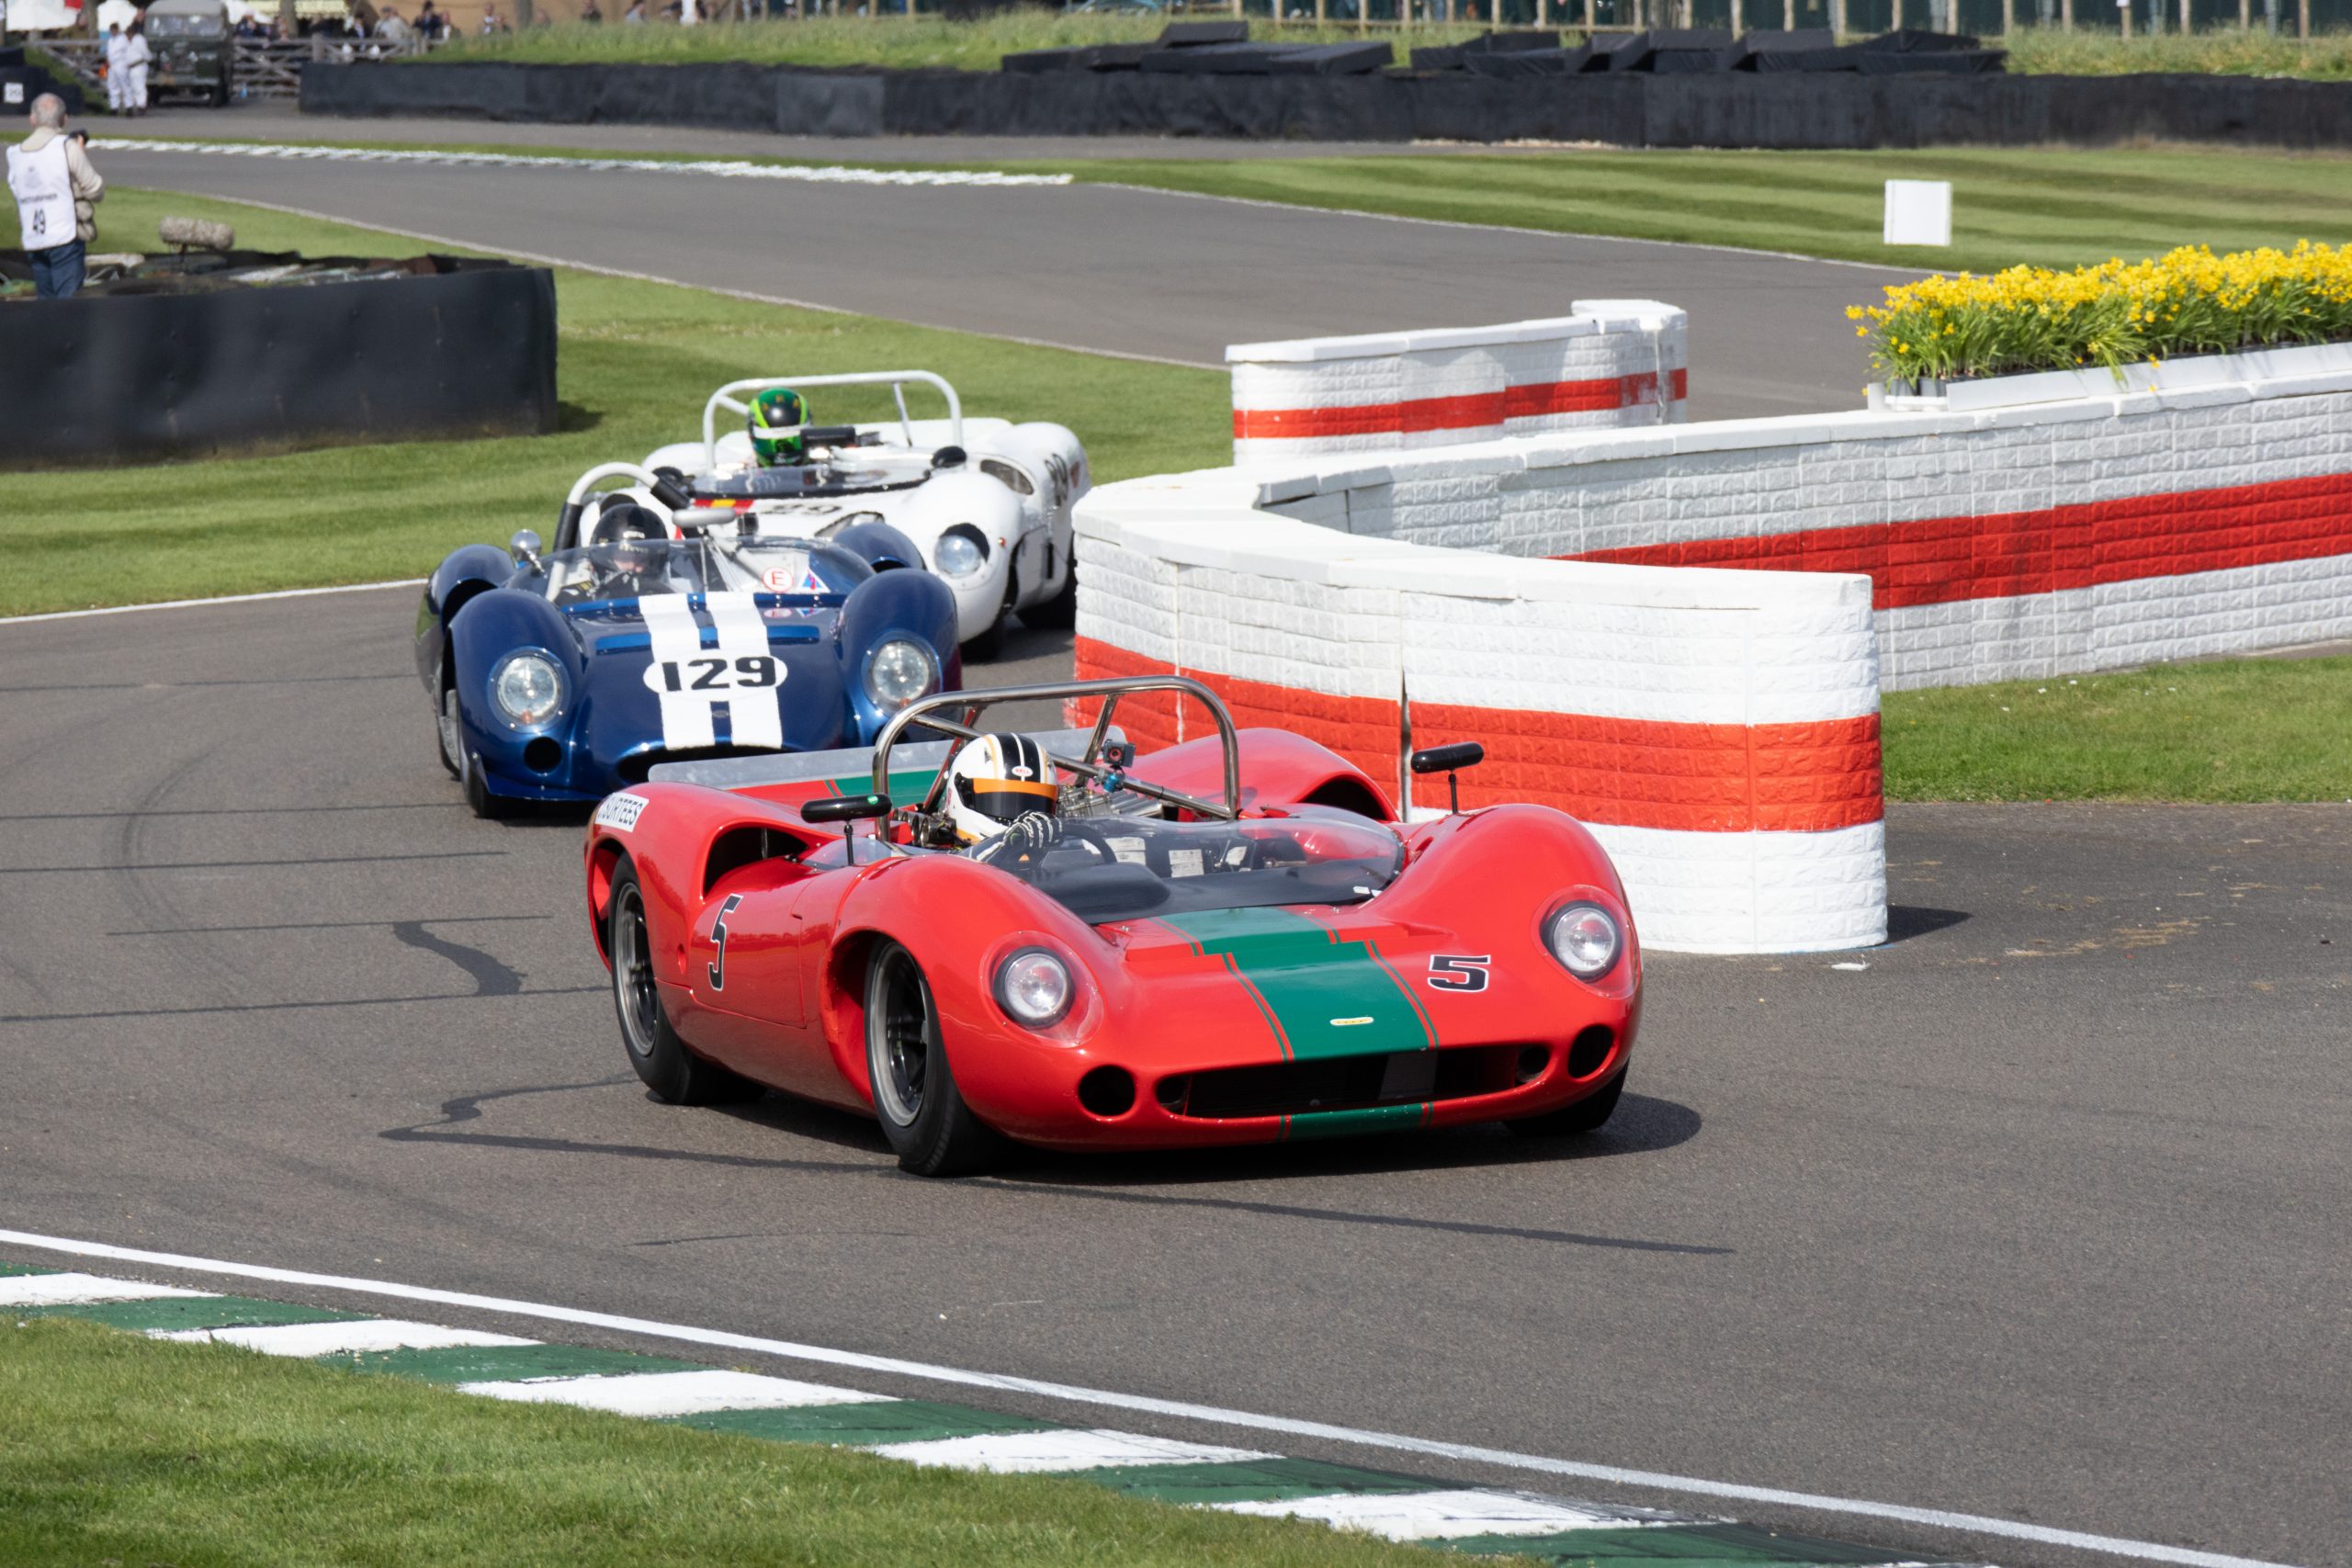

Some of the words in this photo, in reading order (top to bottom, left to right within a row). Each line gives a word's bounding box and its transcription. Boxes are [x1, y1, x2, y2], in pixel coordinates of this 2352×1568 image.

[662, 656, 776, 693] 129
[707, 893, 744, 991] 5
[1428, 954, 1490, 992] 5
